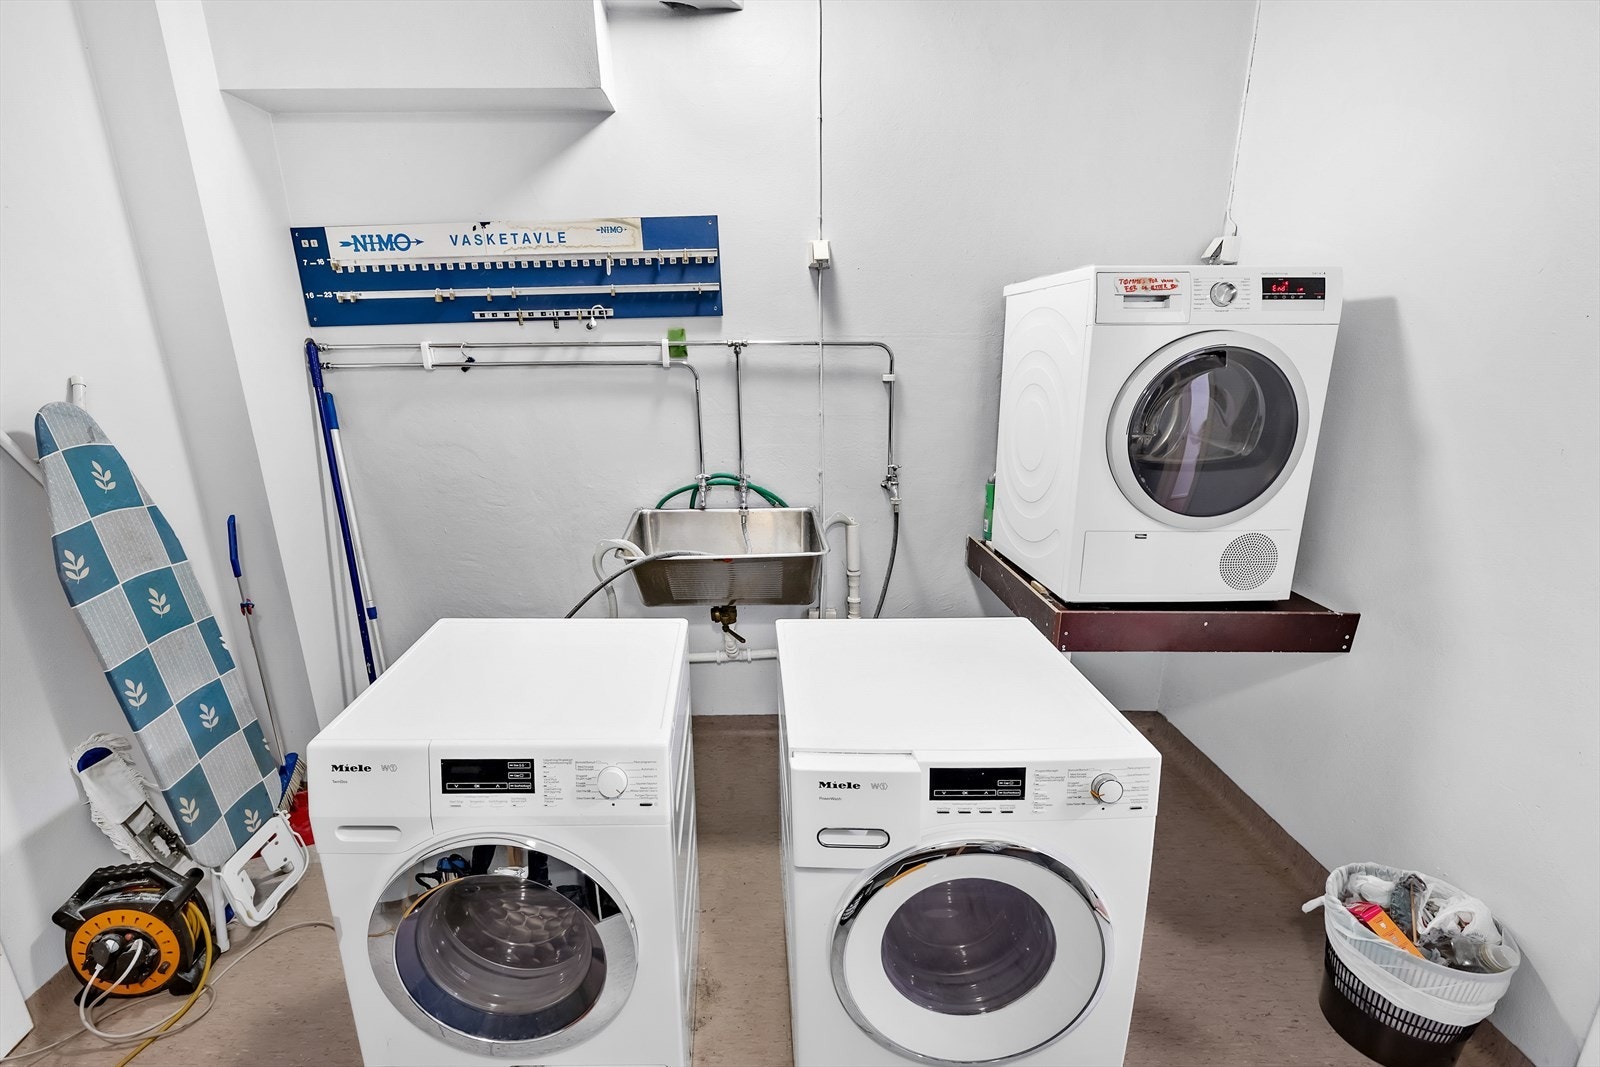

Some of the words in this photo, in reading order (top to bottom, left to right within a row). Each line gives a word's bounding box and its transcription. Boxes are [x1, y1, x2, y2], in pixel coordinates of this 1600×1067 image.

[600, 226, 623, 234] NIMO
[351, 233, 411, 252] NIMO
[449, 231, 567, 246] VASKETAVLE
[331, 763, 372, 772] Miele
[818, 781, 861, 790] Miele
